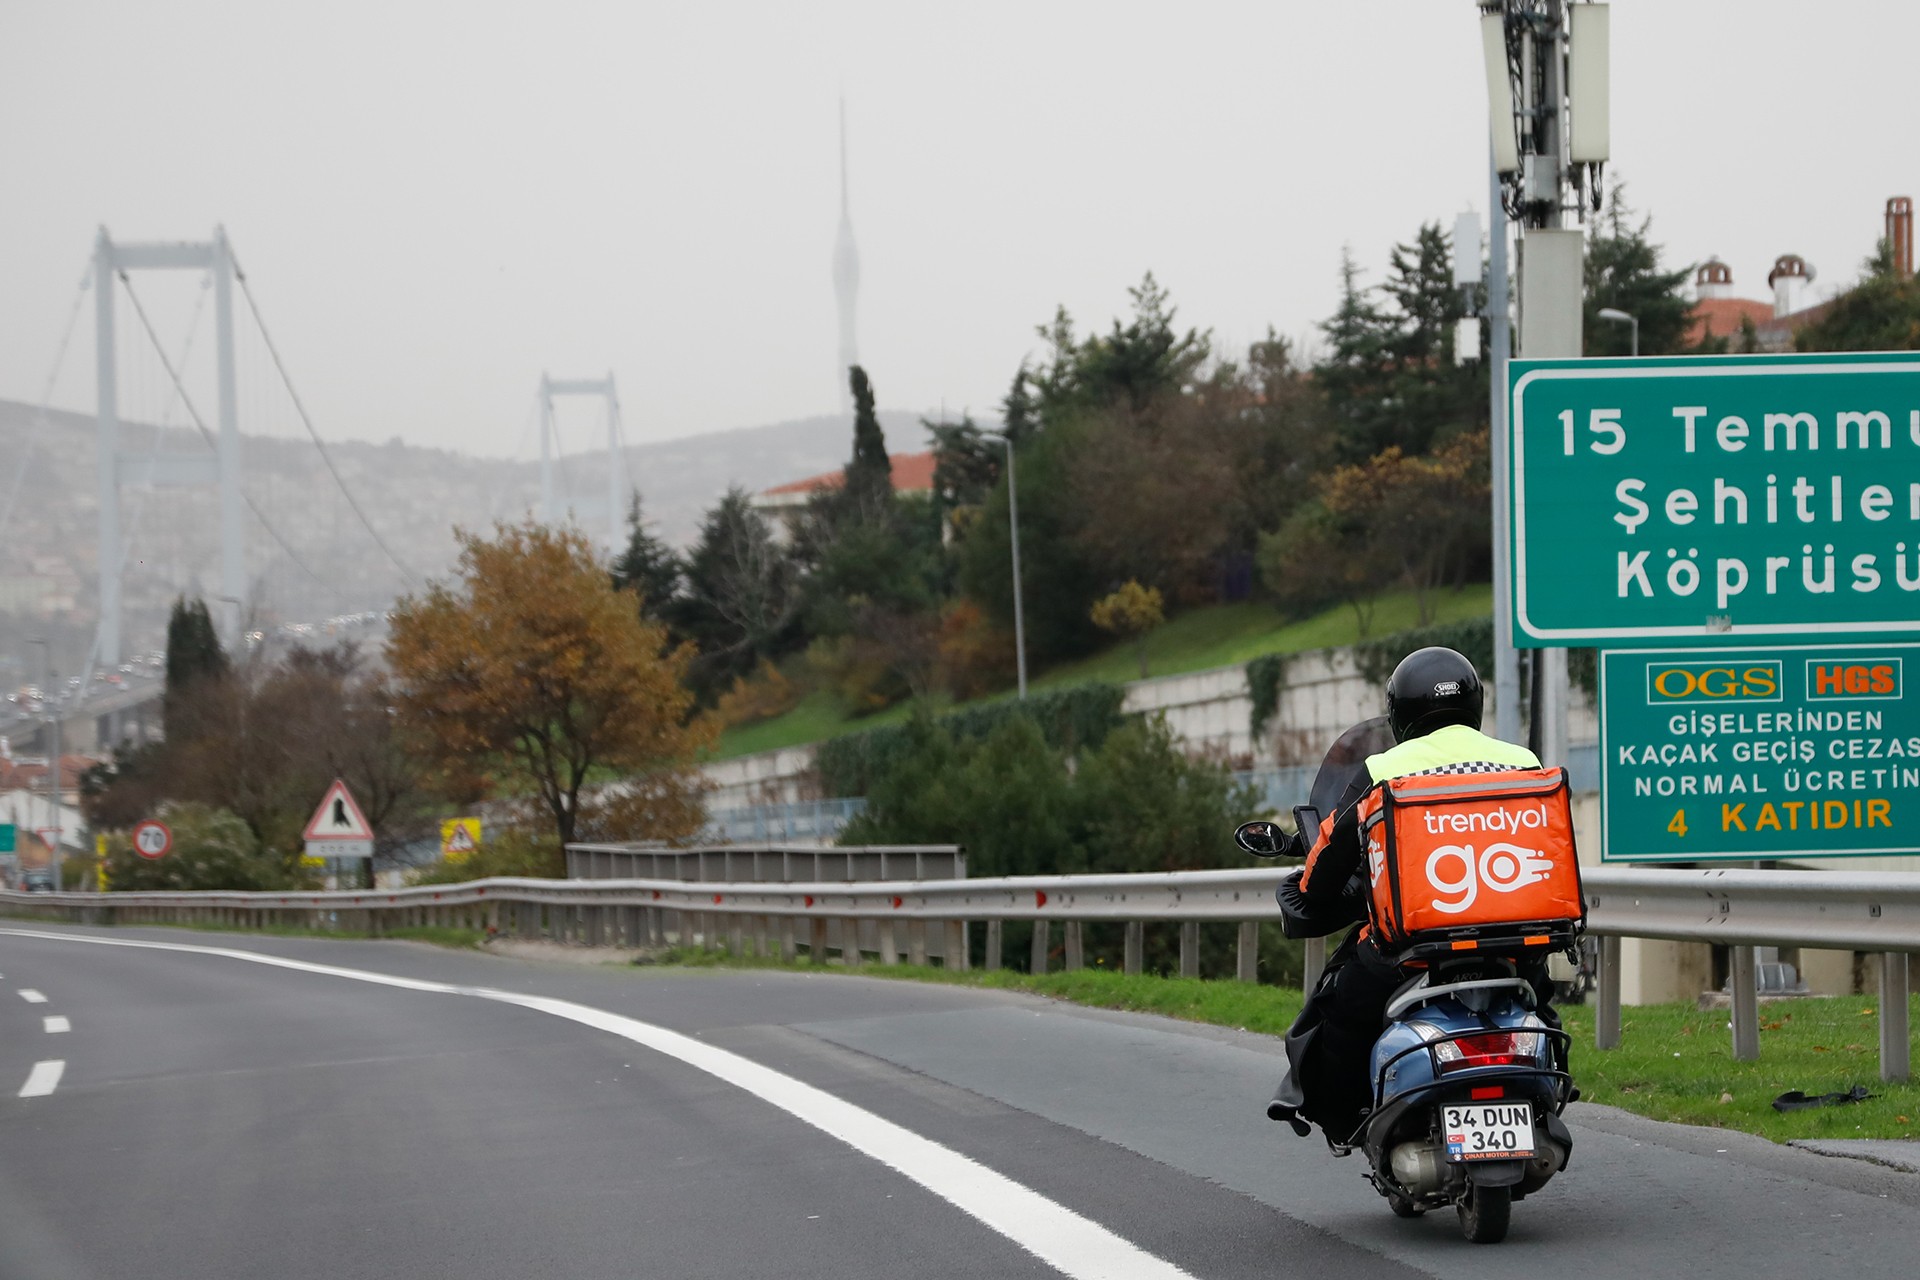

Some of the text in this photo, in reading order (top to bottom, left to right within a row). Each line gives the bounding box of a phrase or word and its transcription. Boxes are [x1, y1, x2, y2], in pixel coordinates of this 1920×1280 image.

[1558, 408, 1627, 456] 15
[1617, 542, 1920, 609] Köprüsü
[1654, 665, 1895, 698] OGS HGS
[1668, 707, 1883, 738] GİŞELERİNDEN
[1618, 736, 1920, 768] KAÇAK GEÇİŞ CEZAS
[1635, 764, 1920, 797] NORMAL ÜCRETİN
[1423, 803, 1548, 835] trendyol
[1667, 798, 1893, 838] 4 KATIDIR
[142, 831, 165, 849] 70
[1425, 842, 1554, 914] go
[1447, 1107, 1529, 1129] 34 DUN
[1450, 1146, 1461, 1154] TR
[1471, 1130, 1517, 1151] 340
[1485, 1151, 1510, 1159] MOTOR
